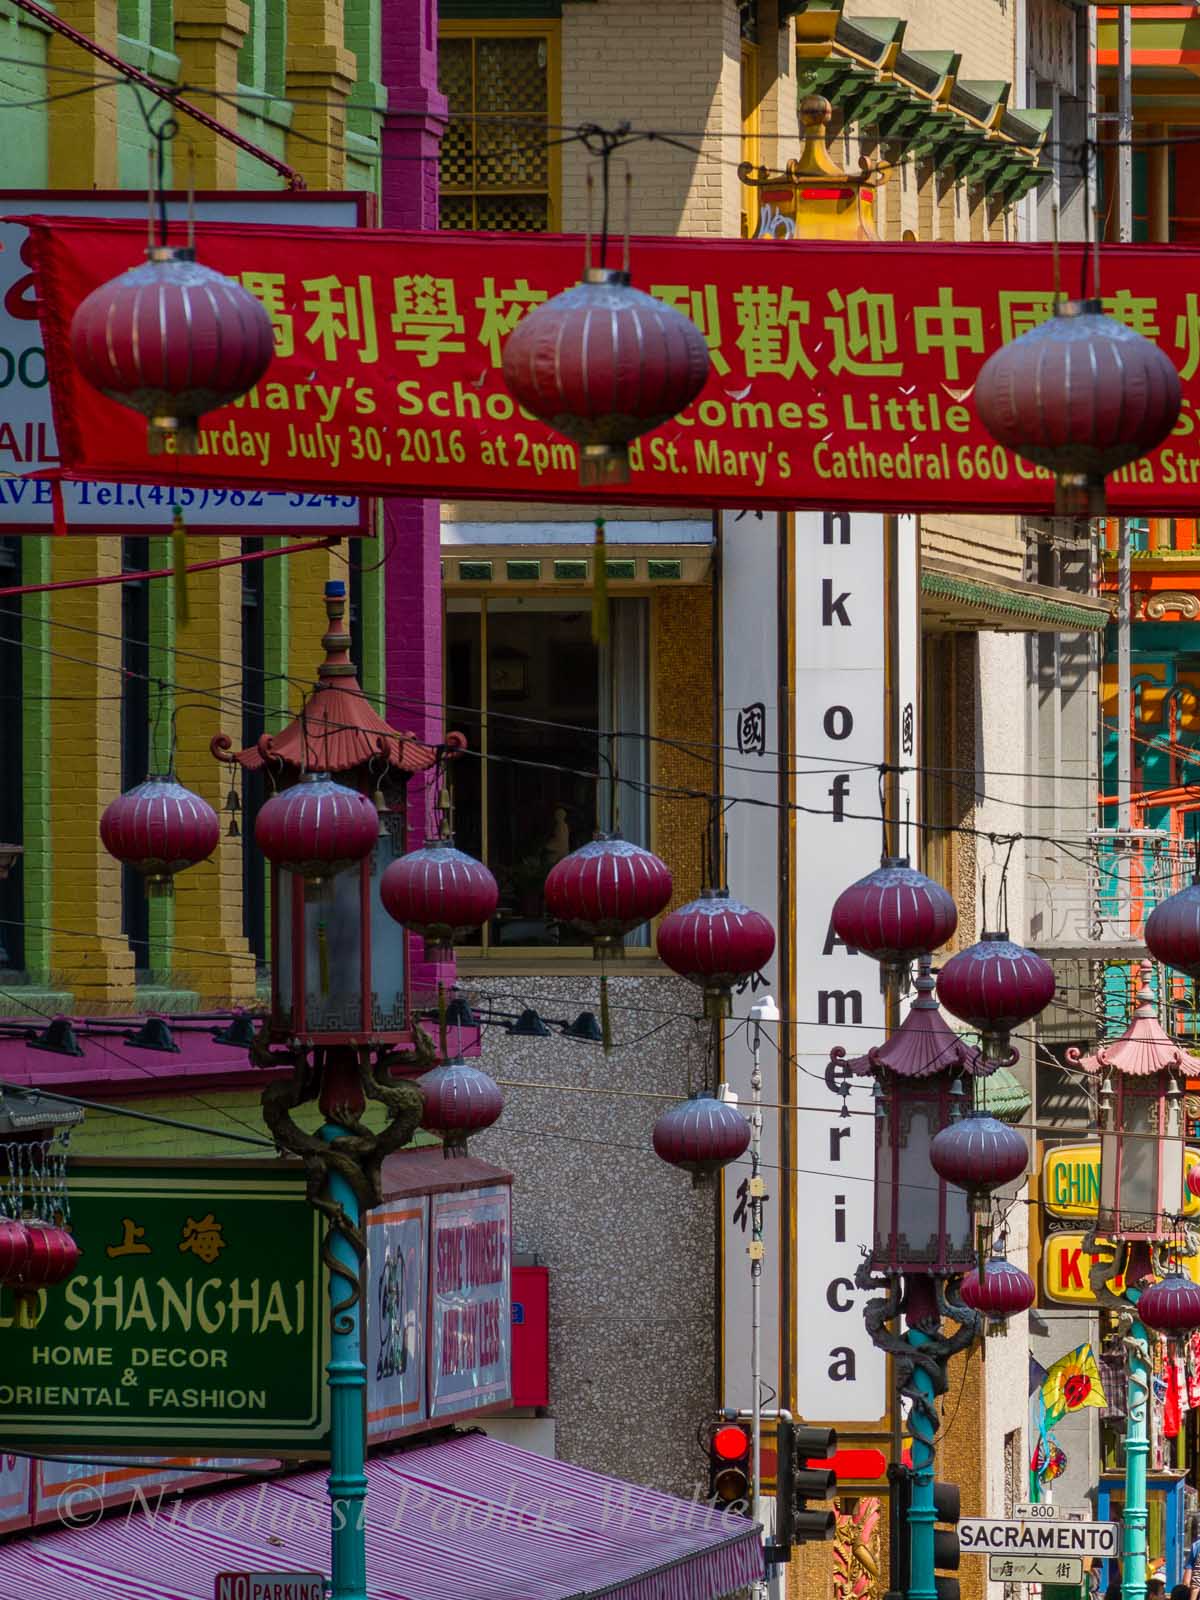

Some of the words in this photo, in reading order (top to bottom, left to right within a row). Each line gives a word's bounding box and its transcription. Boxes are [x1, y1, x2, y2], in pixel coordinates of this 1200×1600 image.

[844, 392, 970, 432] Little
[287, 422, 341, 468] July
[348, 425, 391, 467] 30,
[397, 428, 466, 463] 2016
[480, 434, 509, 467] at
[514, 432, 577, 476] 2pm
[650, 436, 689, 474] St.
[694, 439, 792, 487] Mary's
[813, 440, 950, 480] Cathedral
[957, 444, 1008, 481] 660
[55, 1210, 226, 1264] 上海
[64, 1274, 305, 1335] SHANGHAI
[32, 1346, 113, 1366] HOME
[131, 1348, 229, 1368] DECOR
[121, 1367, 138, 1387] &
[0, 1386, 130, 1407] ORIENTAL
[149, 1388, 266, 1409] FASHION
[1030, 1505, 1055, 1518] 800
[960, 1525, 1114, 1550] SACRAMENTO
[219, 1577, 248, 1600] NO
[253, 1582, 323, 1600] PARKING
